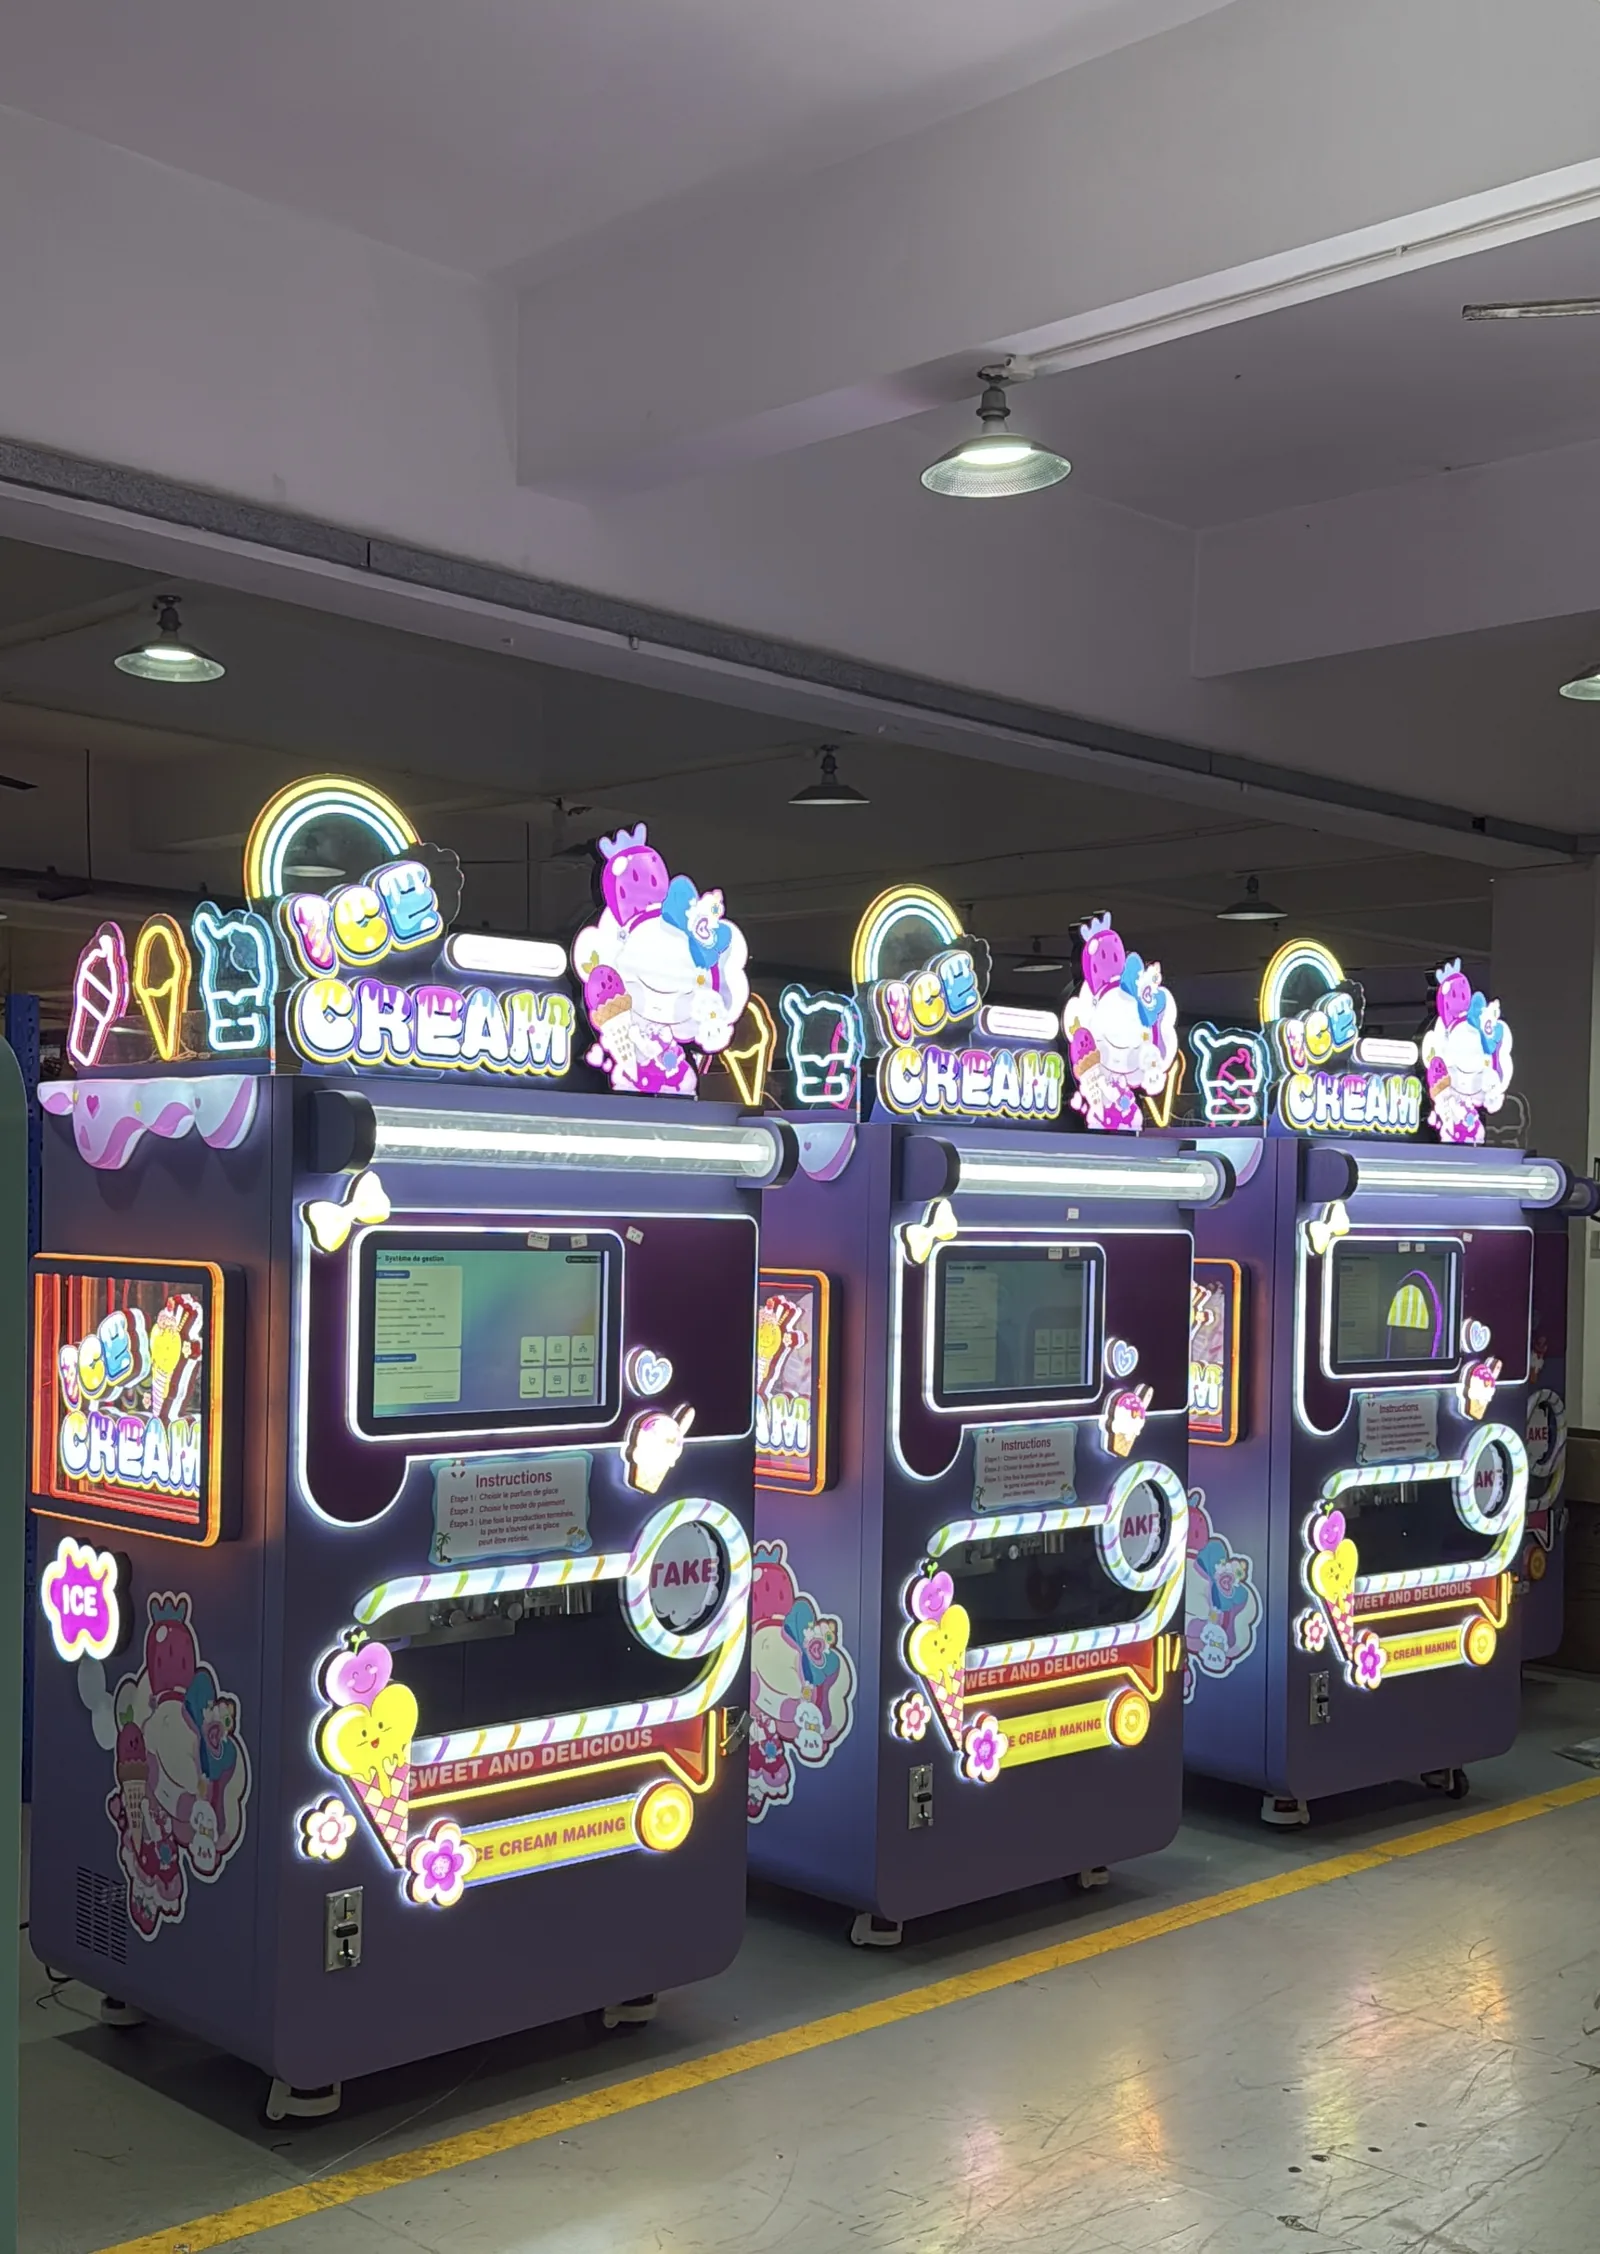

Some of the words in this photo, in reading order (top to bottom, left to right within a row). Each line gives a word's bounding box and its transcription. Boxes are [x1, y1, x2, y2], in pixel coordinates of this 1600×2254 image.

[287, 861, 442, 976] ICE
[884, 951, 981, 1044] ICE
[296, 977, 574, 1070] CREAM
[1284, 992, 1358, 1071] ICE
[888, 1045, 1064, 1114] CREAM
[1286, 1071, 1422, 1129] CREAM
[59, 1311, 134, 1408] ICE
[61, 1411, 200, 1493] CREAM
[1001, 1437, 1052, 1451] Instructions
[1527, 1427, 1548, 1441] AKE
[476, 1470, 552, 1488] Instructions
[1122, 1514, 1159, 1538] AKE
[651, 1558, 717, 1589] TAKE
[1355, 1593, 1386, 1610] WEET
[1388, 1589, 1412, 1605] AND
[1414, 1581, 1472, 1602] DELICIOUS
[62, 1583, 98, 1617] ICE
[965, 1668, 1007, 1690] WEET
[1010, 1662, 1040, 1682] AND
[1044, 1647, 1119, 1675] DELICIOUS
[1393, 1645, 1422, 1659] CREAM
[1424, 1640, 1457, 1654] MAKING
[488, 1751, 534, 1777] AND
[541, 1728, 653, 1767] DELICIOUS
[1019, 1726, 1057, 1746] CREAM
[1060, 1718, 1102, 1737] MAKING
[476, 1845, 494, 1863] CE
[500, 1832, 558, 1858] CREAM
[563, 1817, 626, 1845] MAKING
